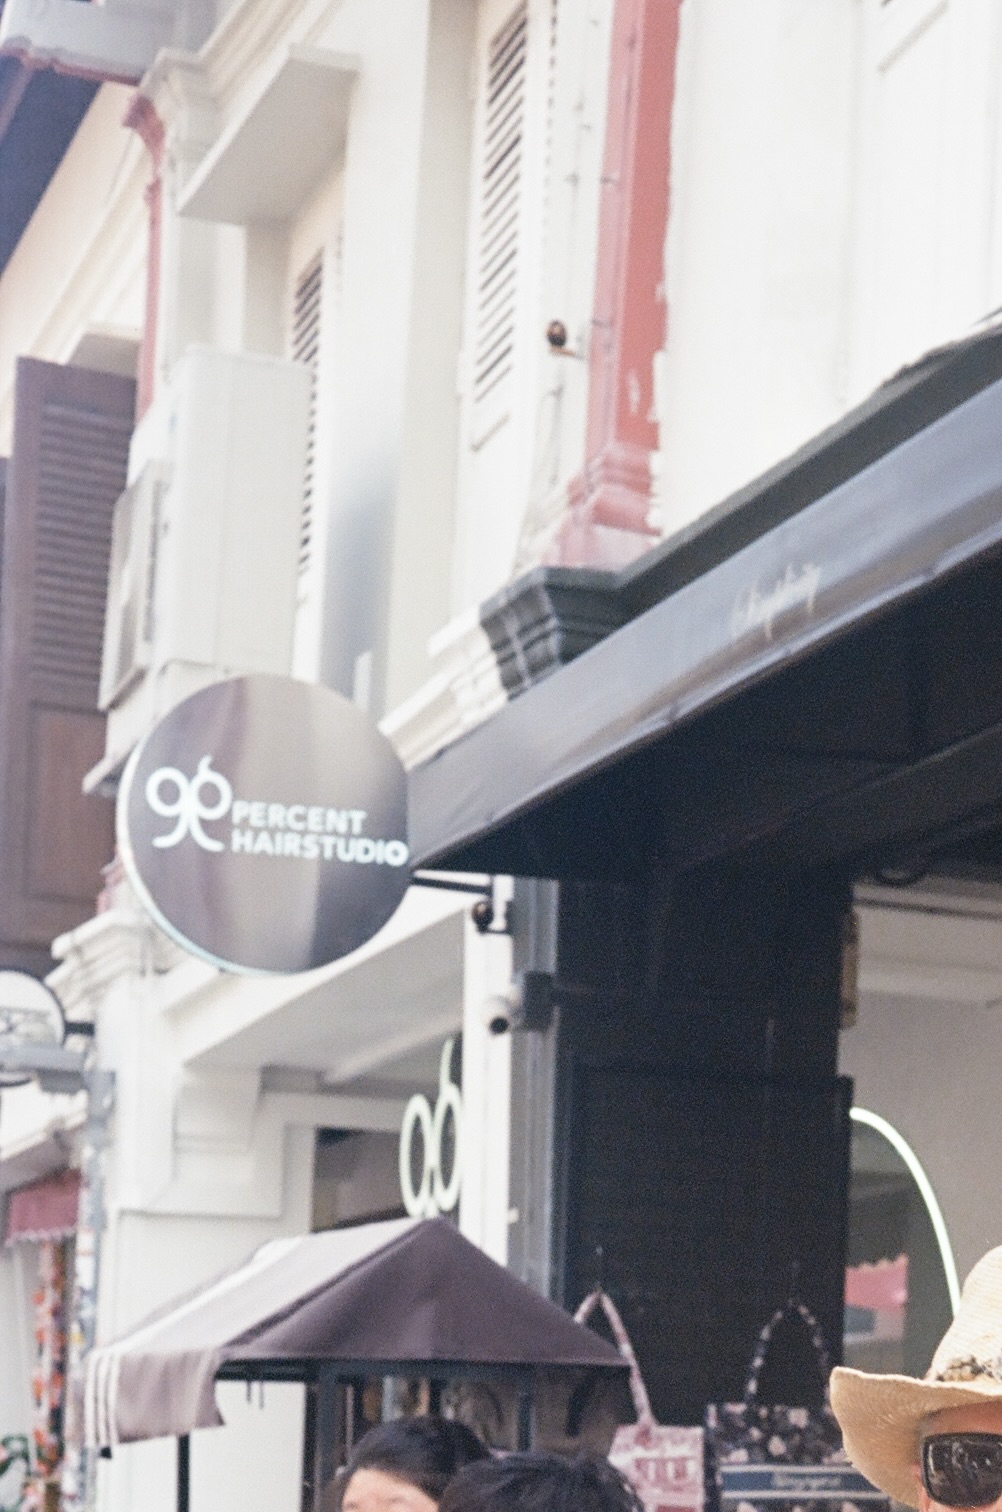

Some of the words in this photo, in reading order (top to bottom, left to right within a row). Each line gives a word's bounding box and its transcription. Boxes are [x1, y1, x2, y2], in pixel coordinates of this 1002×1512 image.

[145, 755, 233, 852] 96
[232, 800, 367, 835] PERCENT
[231, 828, 410, 866] HAIRSTUDIO
